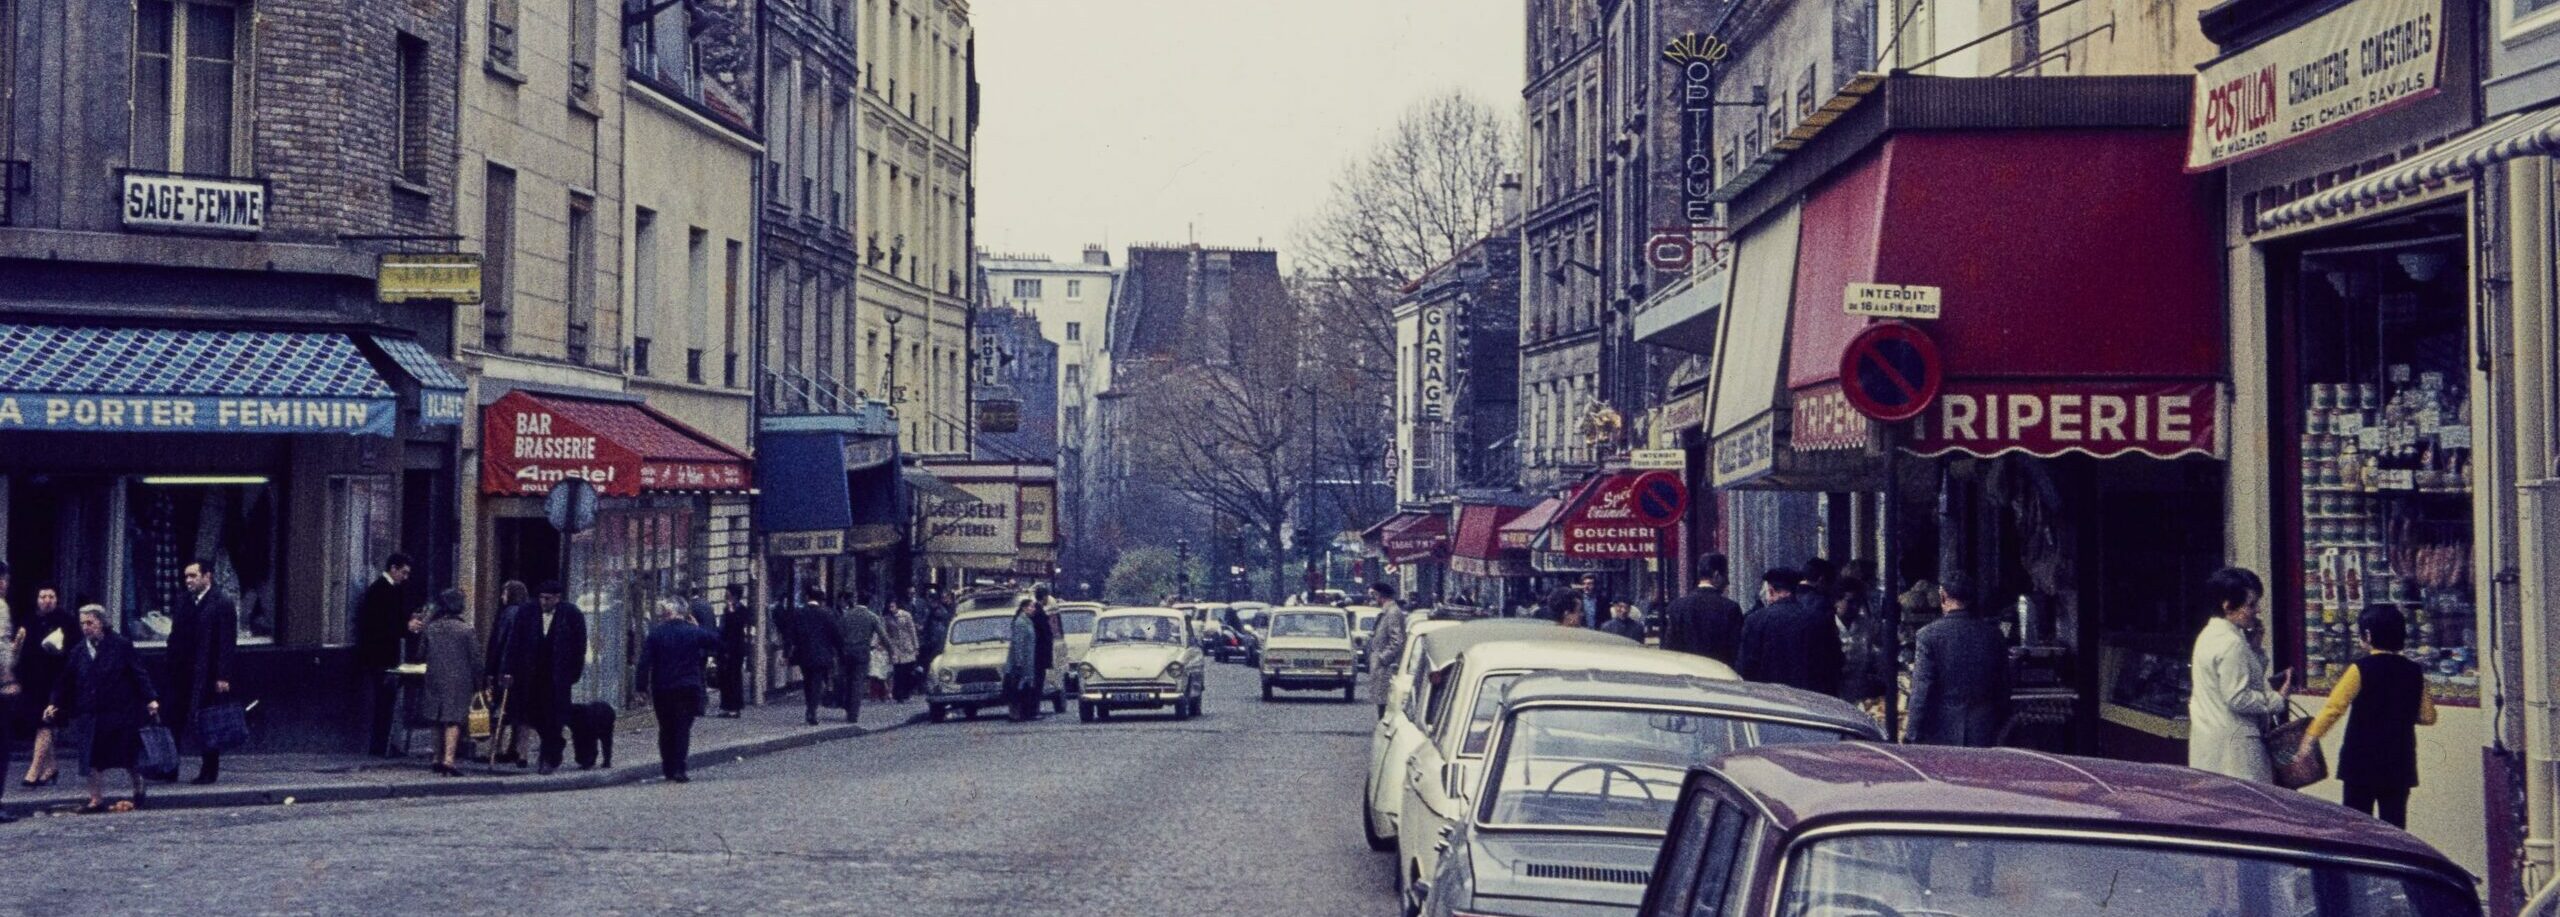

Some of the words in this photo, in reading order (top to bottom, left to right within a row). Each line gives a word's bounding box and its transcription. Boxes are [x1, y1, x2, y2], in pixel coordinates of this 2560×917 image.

[2361, 12, 2432, 77] COMESTIBLES
[2206, 62, 2276, 142] POSTILLON
[1687, 61, 1710, 221] OPTIQUE
[129, 182, 260, 226] SAGE-FEMME
[1860, 288, 1926, 300] INTERDIT
[1426, 310, 1441, 417] GARAGE
[47, 398, 197, 426] PORTER
[219, 399, 368, 427] FEMININ
[516, 412, 552, 435] BAR
[514, 436, 596, 460] BRASSERIE
[516, 465, 615, 482] Amstel
